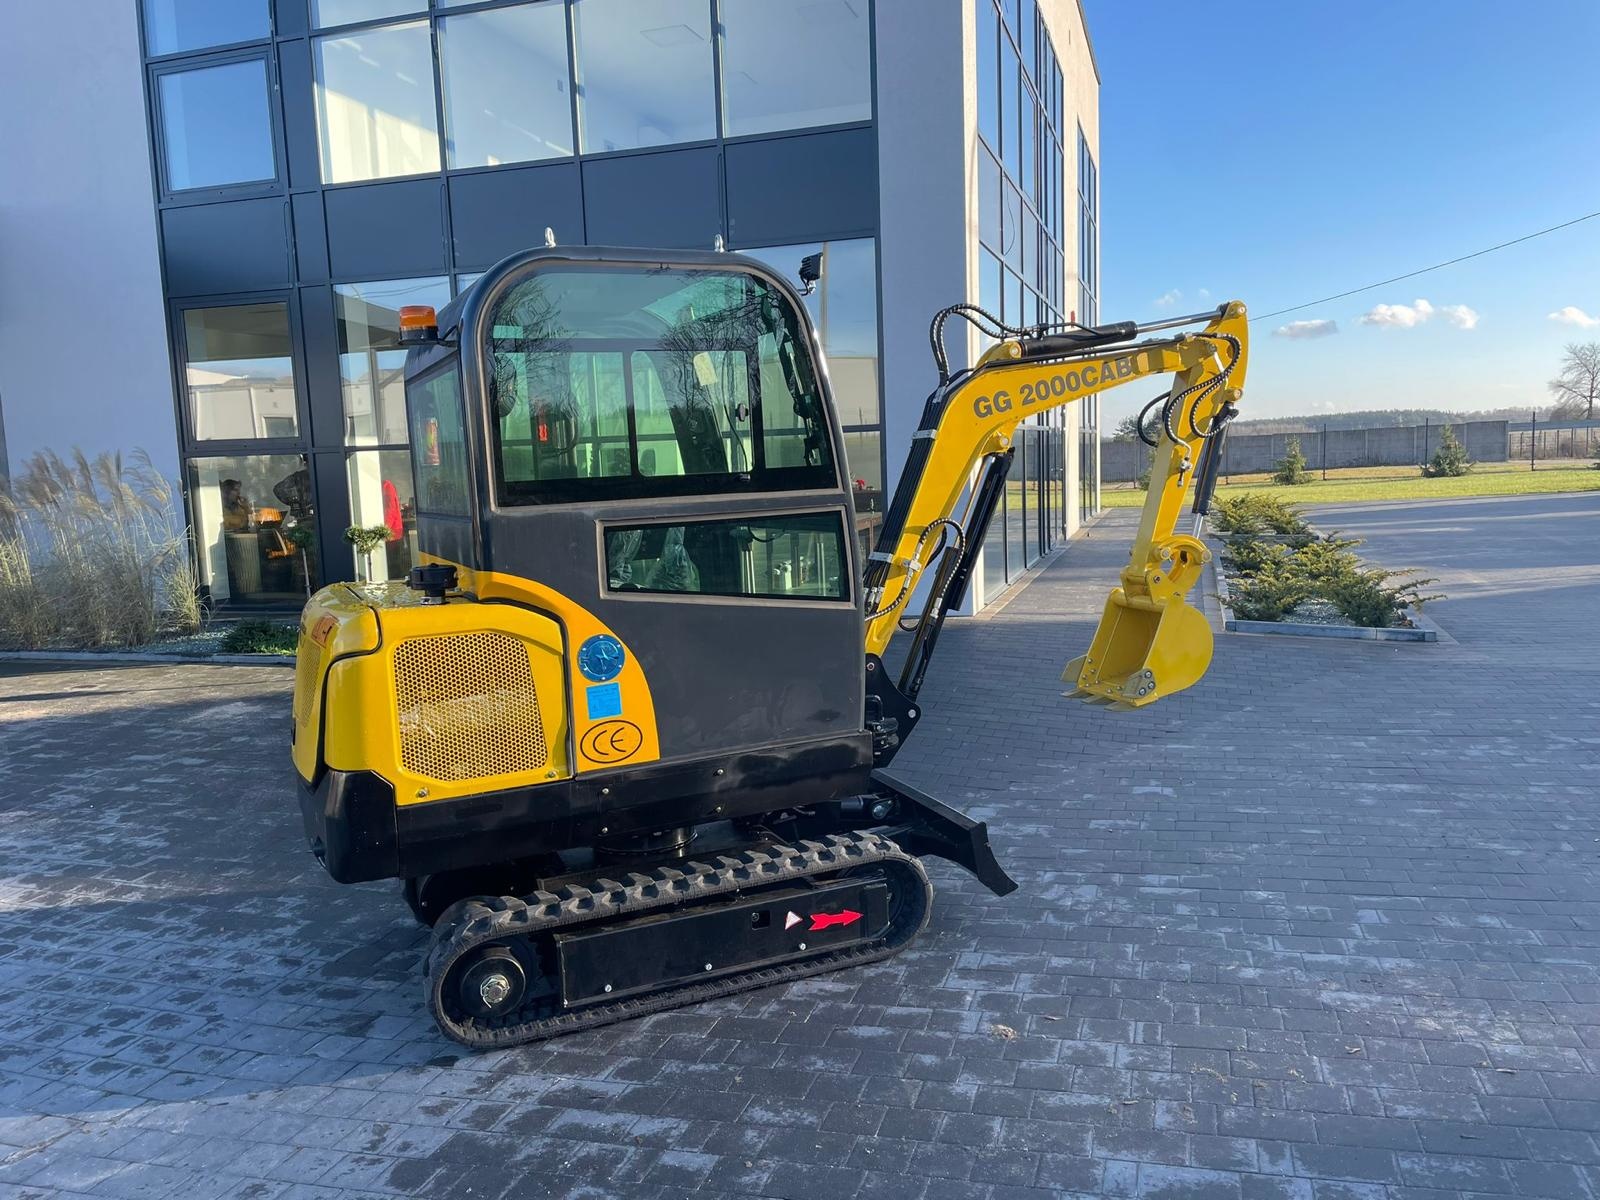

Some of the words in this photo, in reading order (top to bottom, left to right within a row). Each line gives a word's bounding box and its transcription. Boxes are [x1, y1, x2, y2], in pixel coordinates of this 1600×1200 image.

[973, 391, 1013, 418] GG
[1019, 357, 1132, 406] 2000CAB
[592, 726, 627, 756] CE
